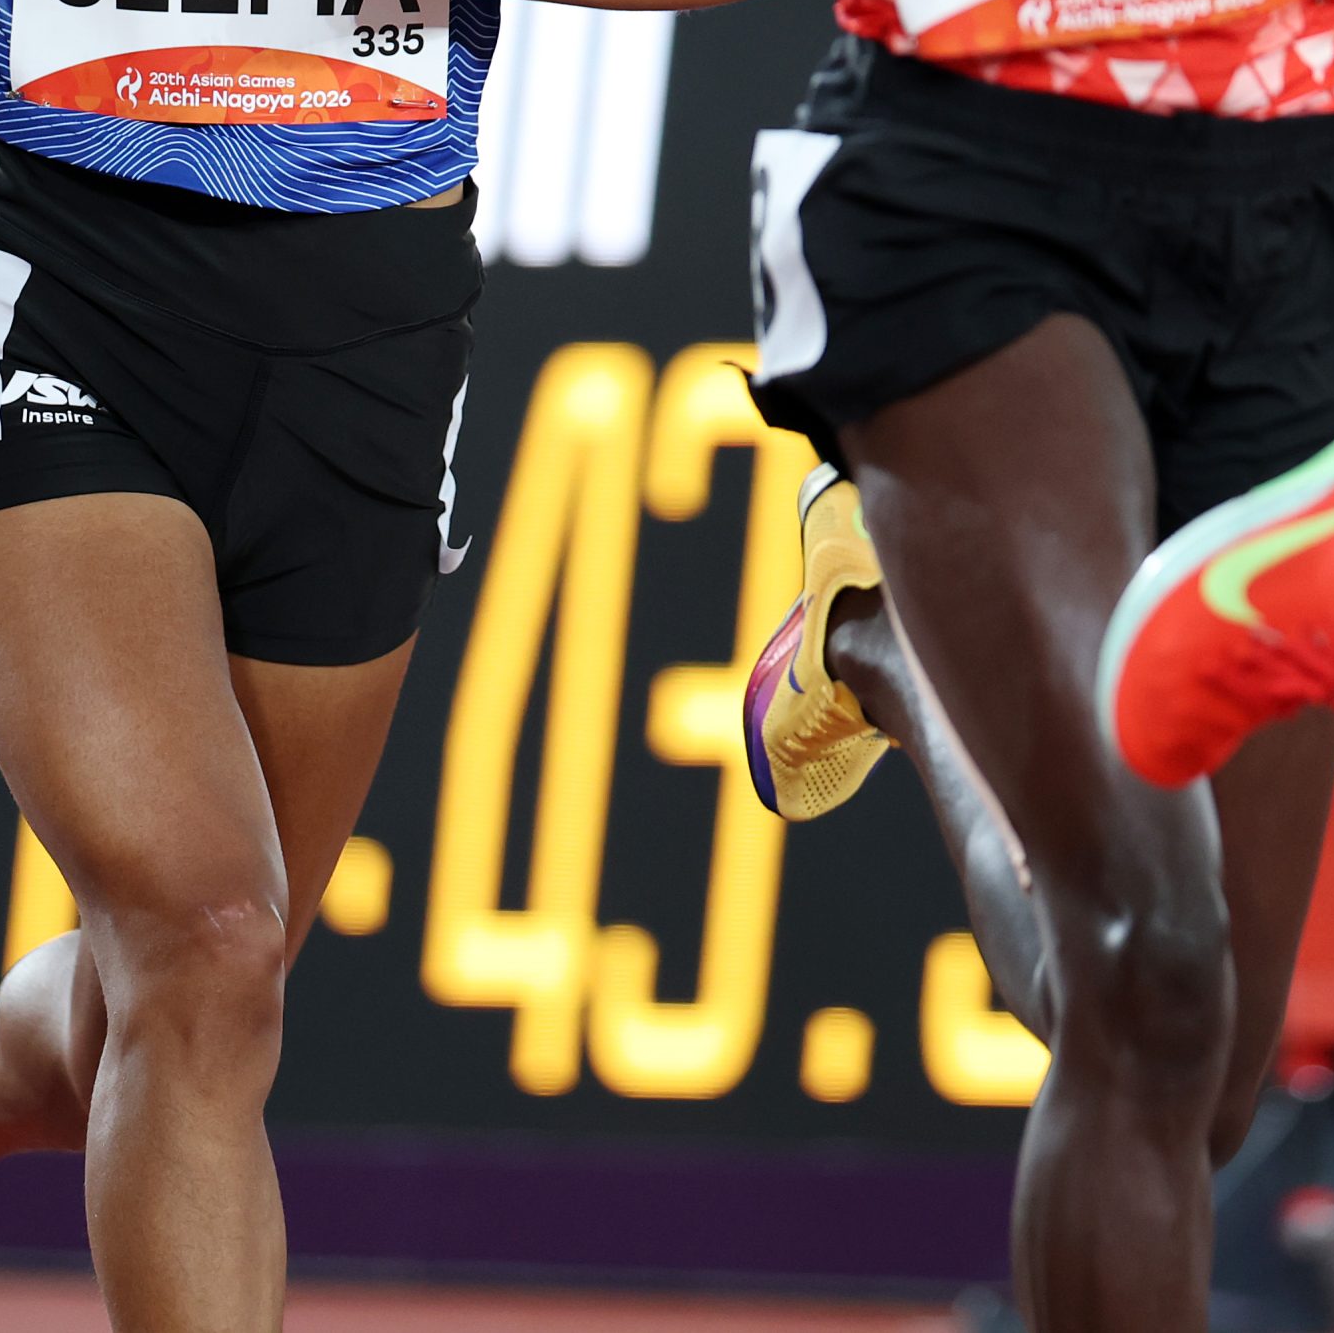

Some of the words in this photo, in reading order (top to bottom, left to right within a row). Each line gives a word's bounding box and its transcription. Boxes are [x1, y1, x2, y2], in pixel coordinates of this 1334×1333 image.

[352, 22, 424, 57] 335
[149, 72, 185, 86] 20th
[189, 73, 233, 87] Asian
[238, 74, 295, 88] Games
[149, 88, 294, 113] Aichi-Nagoya
[299, 90, 352, 108] 2026
[22, 408, 94, 425] Inspire
